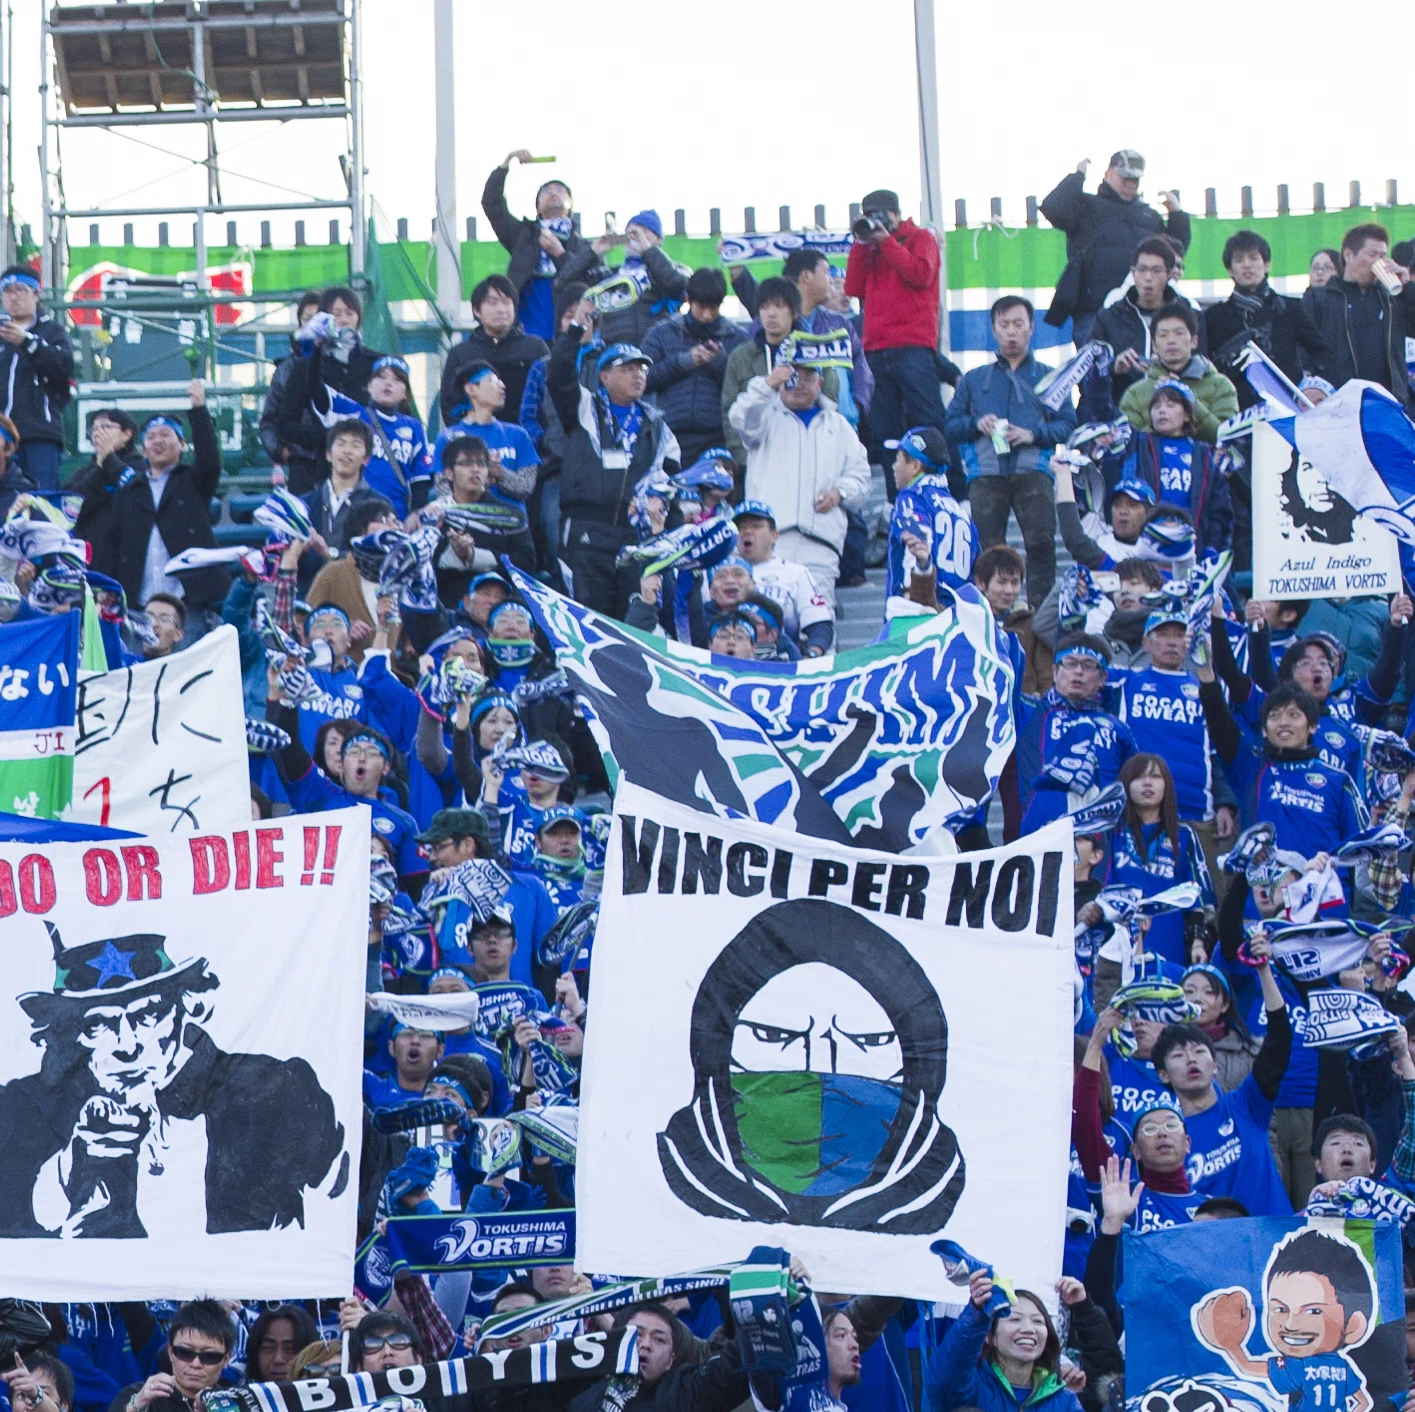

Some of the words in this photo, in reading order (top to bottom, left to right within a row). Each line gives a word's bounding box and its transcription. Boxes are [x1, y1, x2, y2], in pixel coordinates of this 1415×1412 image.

[935, 511, 971, 580] 26
[1280, 556, 1316, 573] Azul
[1326, 555, 1372, 570] Indigo
[1269, 575, 1337, 594] TOKUSHIMA
[1344, 573, 1387, 589] VORTIS
[83, 845, 162, 907] OR
[189, 831, 286, 896] DIE
[300, 824, 343, 886] !!
[619, 814, 792, 900] VINCI
[808, 858, 928, 919] PER
[945, 850, 1063, 938] NOI
[435, 1217, 568, 1265] VORTIS
[483, 1221, 566, 1235] TOKUSHIMA
[1312, 1384, 1338, 1407] 11
